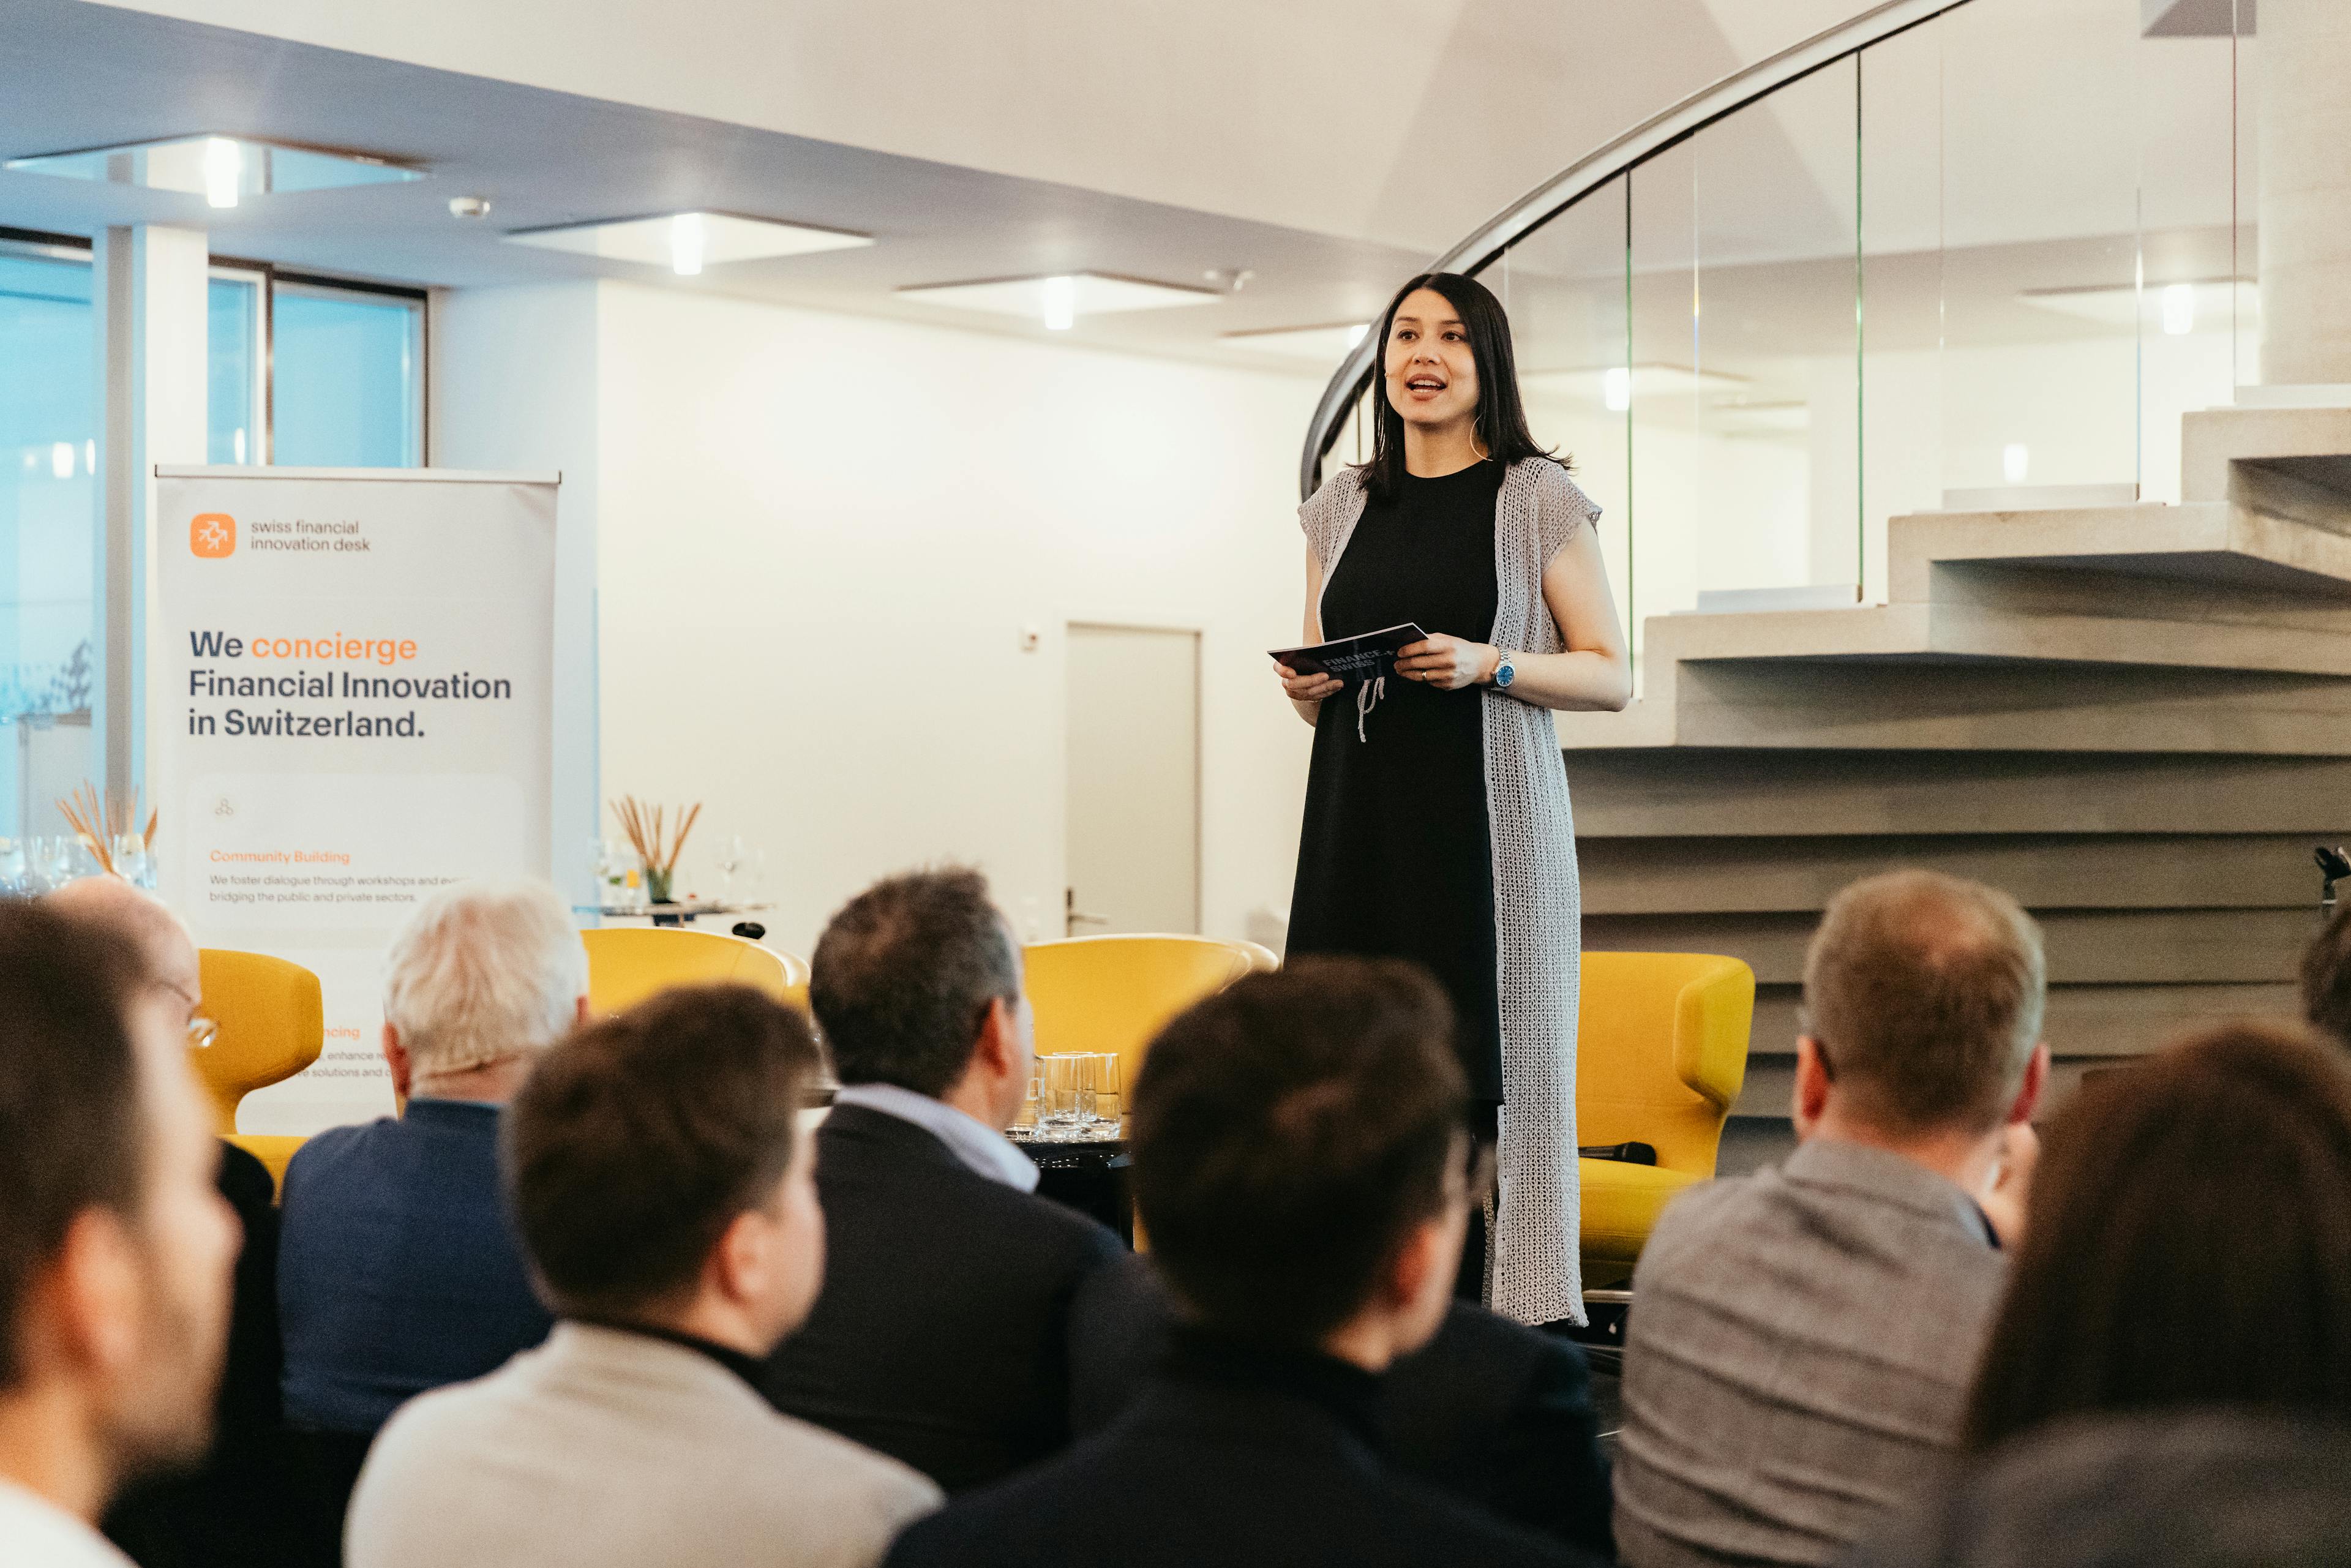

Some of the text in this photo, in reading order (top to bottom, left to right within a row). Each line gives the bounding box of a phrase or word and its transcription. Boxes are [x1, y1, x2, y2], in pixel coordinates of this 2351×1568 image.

[251, 519, 359, 535] swiss financial
[251, 536, 371, 552] innovation desk
[190, 631, 418, 666] We concierge
[1330, 659, 1376, 672] SWISS
[190, 669, 511, 699] Financial Innovation
[189, 708, 424, 737] in Switzerland.
[209, 849, 350, 866] Community Building
[209, 875, 228, 885] We
[231, 875, 260, 885] foster
[263, 875, 310, 887] dialogue
[313, 876, 354, 887] through
[357, 876, 414, 887] workshops
[418, 876, 438, 885] and
[209, 891, 255, 904] bridging
[258, 891, 274, 901] the
[277, 891, 310, 903] public
[313, 892, 334, 902] and
[336, 893, 372, 904] private
[324, 1025, 361, 1040] ncing
[328, 1051, 373, 1060] enhance
[312, 1067, 360, 1078] solutions
[362, 1068, 383, 1078] and
